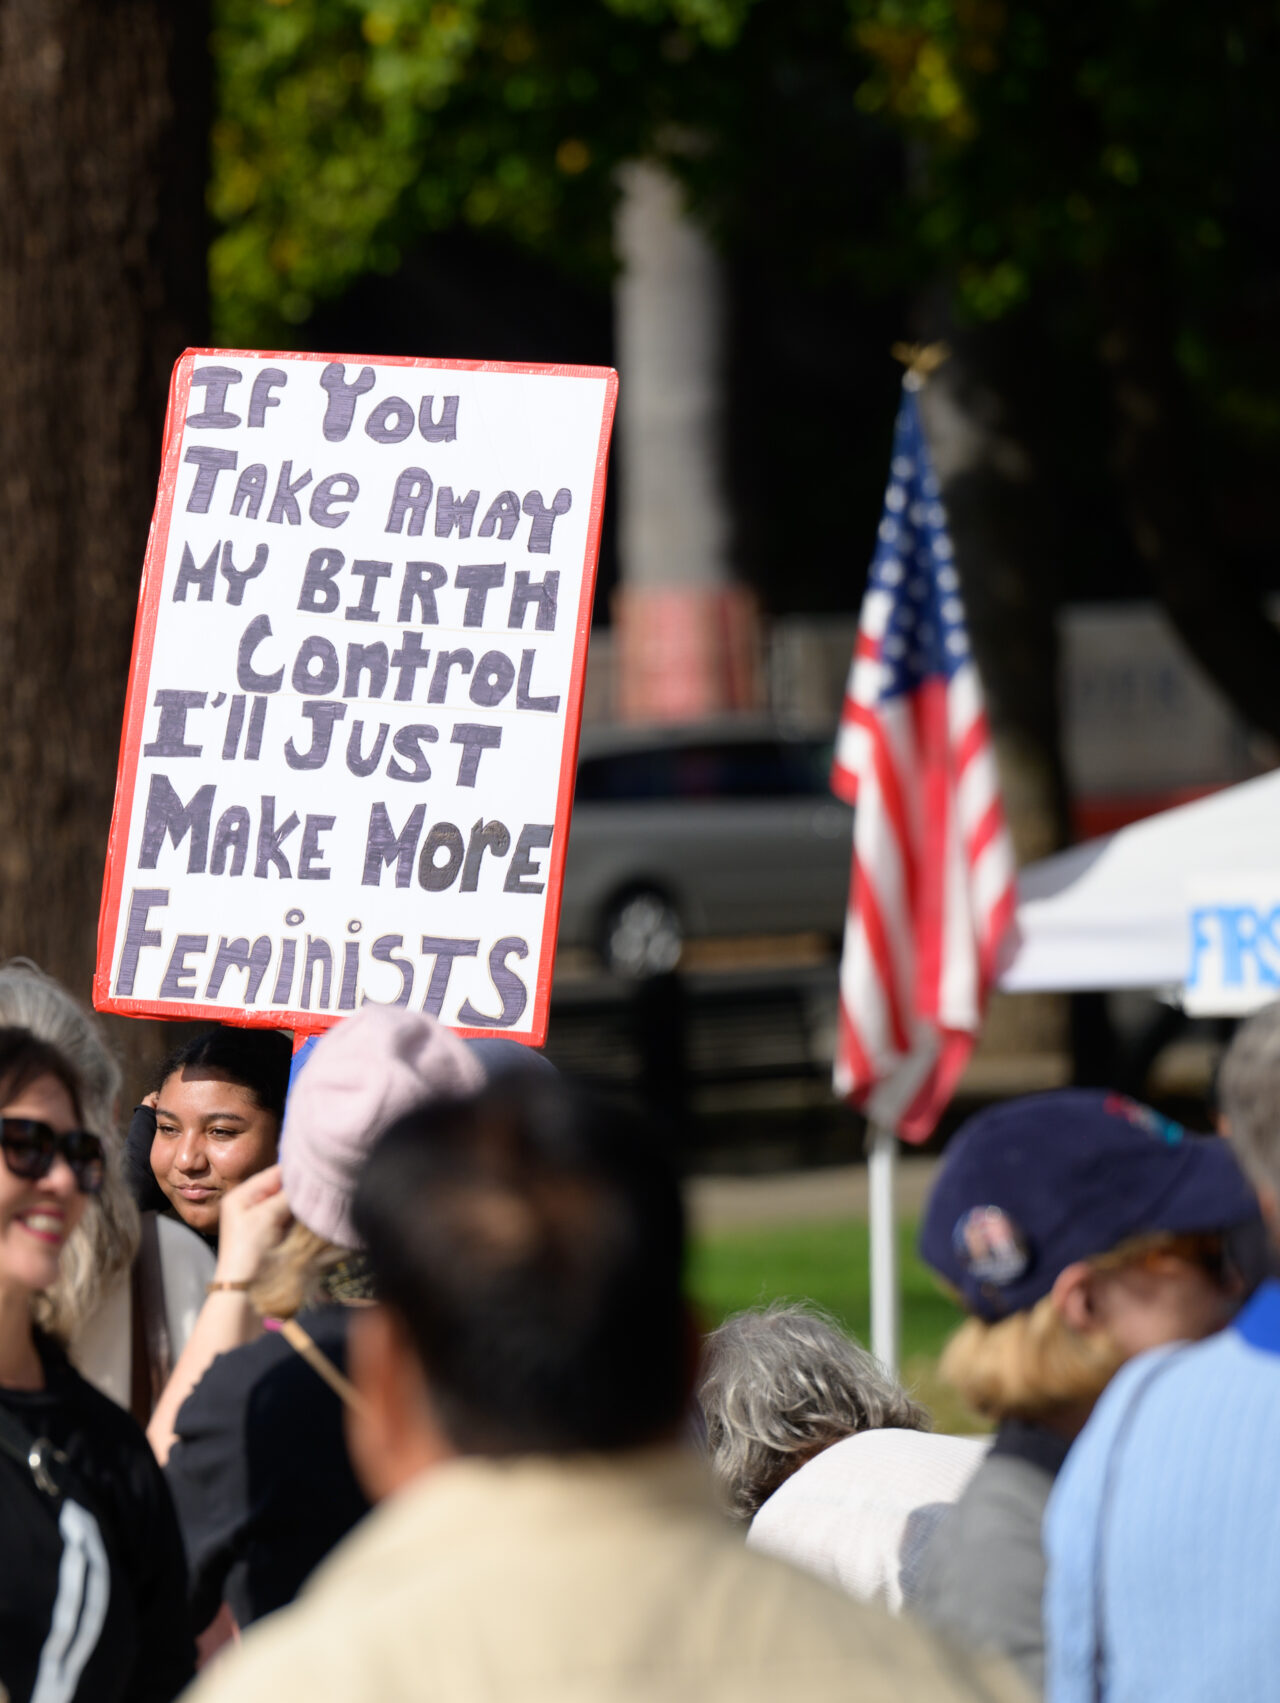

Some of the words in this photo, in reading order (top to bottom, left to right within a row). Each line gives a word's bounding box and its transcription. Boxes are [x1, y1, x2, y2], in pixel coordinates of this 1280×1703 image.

[172, 540, 269, 606] MY
[297, 547, 560, 631] BIRTH
[284, 700, 502, 788] JUST
